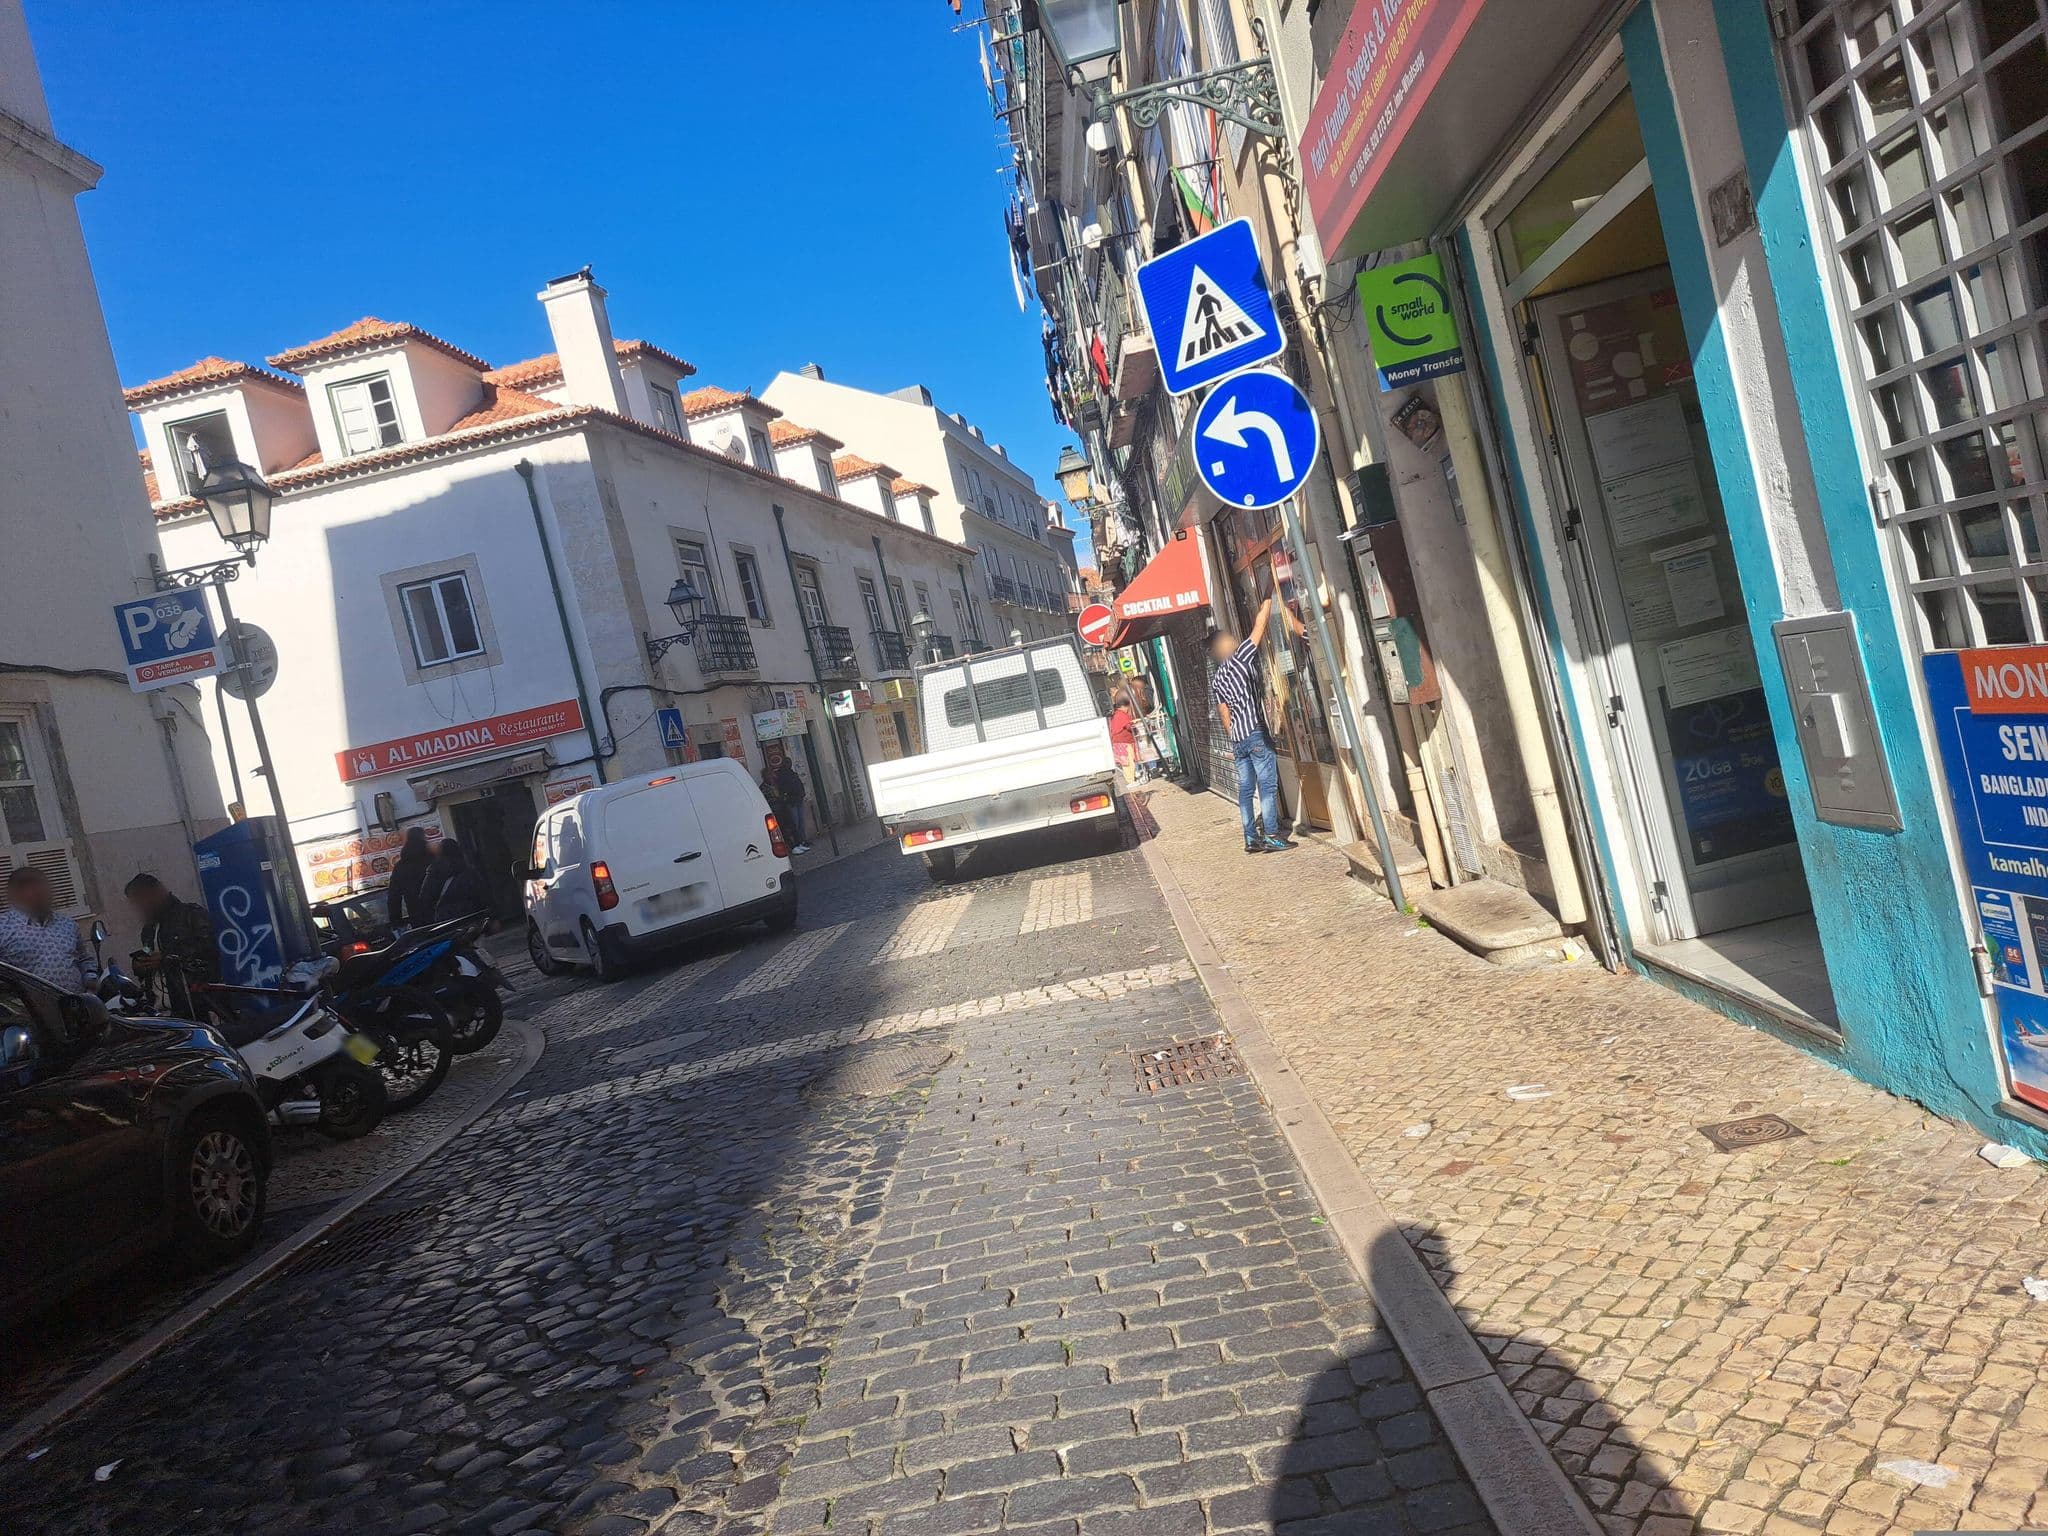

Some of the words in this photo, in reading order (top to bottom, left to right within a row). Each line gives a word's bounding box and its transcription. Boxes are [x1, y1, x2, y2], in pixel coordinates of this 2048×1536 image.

[1346, 31, 1377, 100] Sweets
[1372, 7, 1386, 44] &
[1382, 0, 1403, 27] Re
[1391, 295, 1423, 315] small
[1401, 301, 1435, 321] world
[1388, 367, 1421, 381] Money
[1422, 356, 1464, 372] Transfer
[156, 604, 182, 619] 038
[1122, 596, 1173, 617] COCKTAIL
[1176, 590, 1200, 607] BAR
[123, 606, 157, 650] P
[156, 661, 180, 671] TARIFA
[1974, 662, 2048, 699] MON
[388, 747, 413, 764] AL
[415, 726, 495, 758] MADINA
[497, 711, 566, 736] Restaurante
[2022, 805, 2048, 828] IND
[1988, 851, 2048, 878] kamalh
